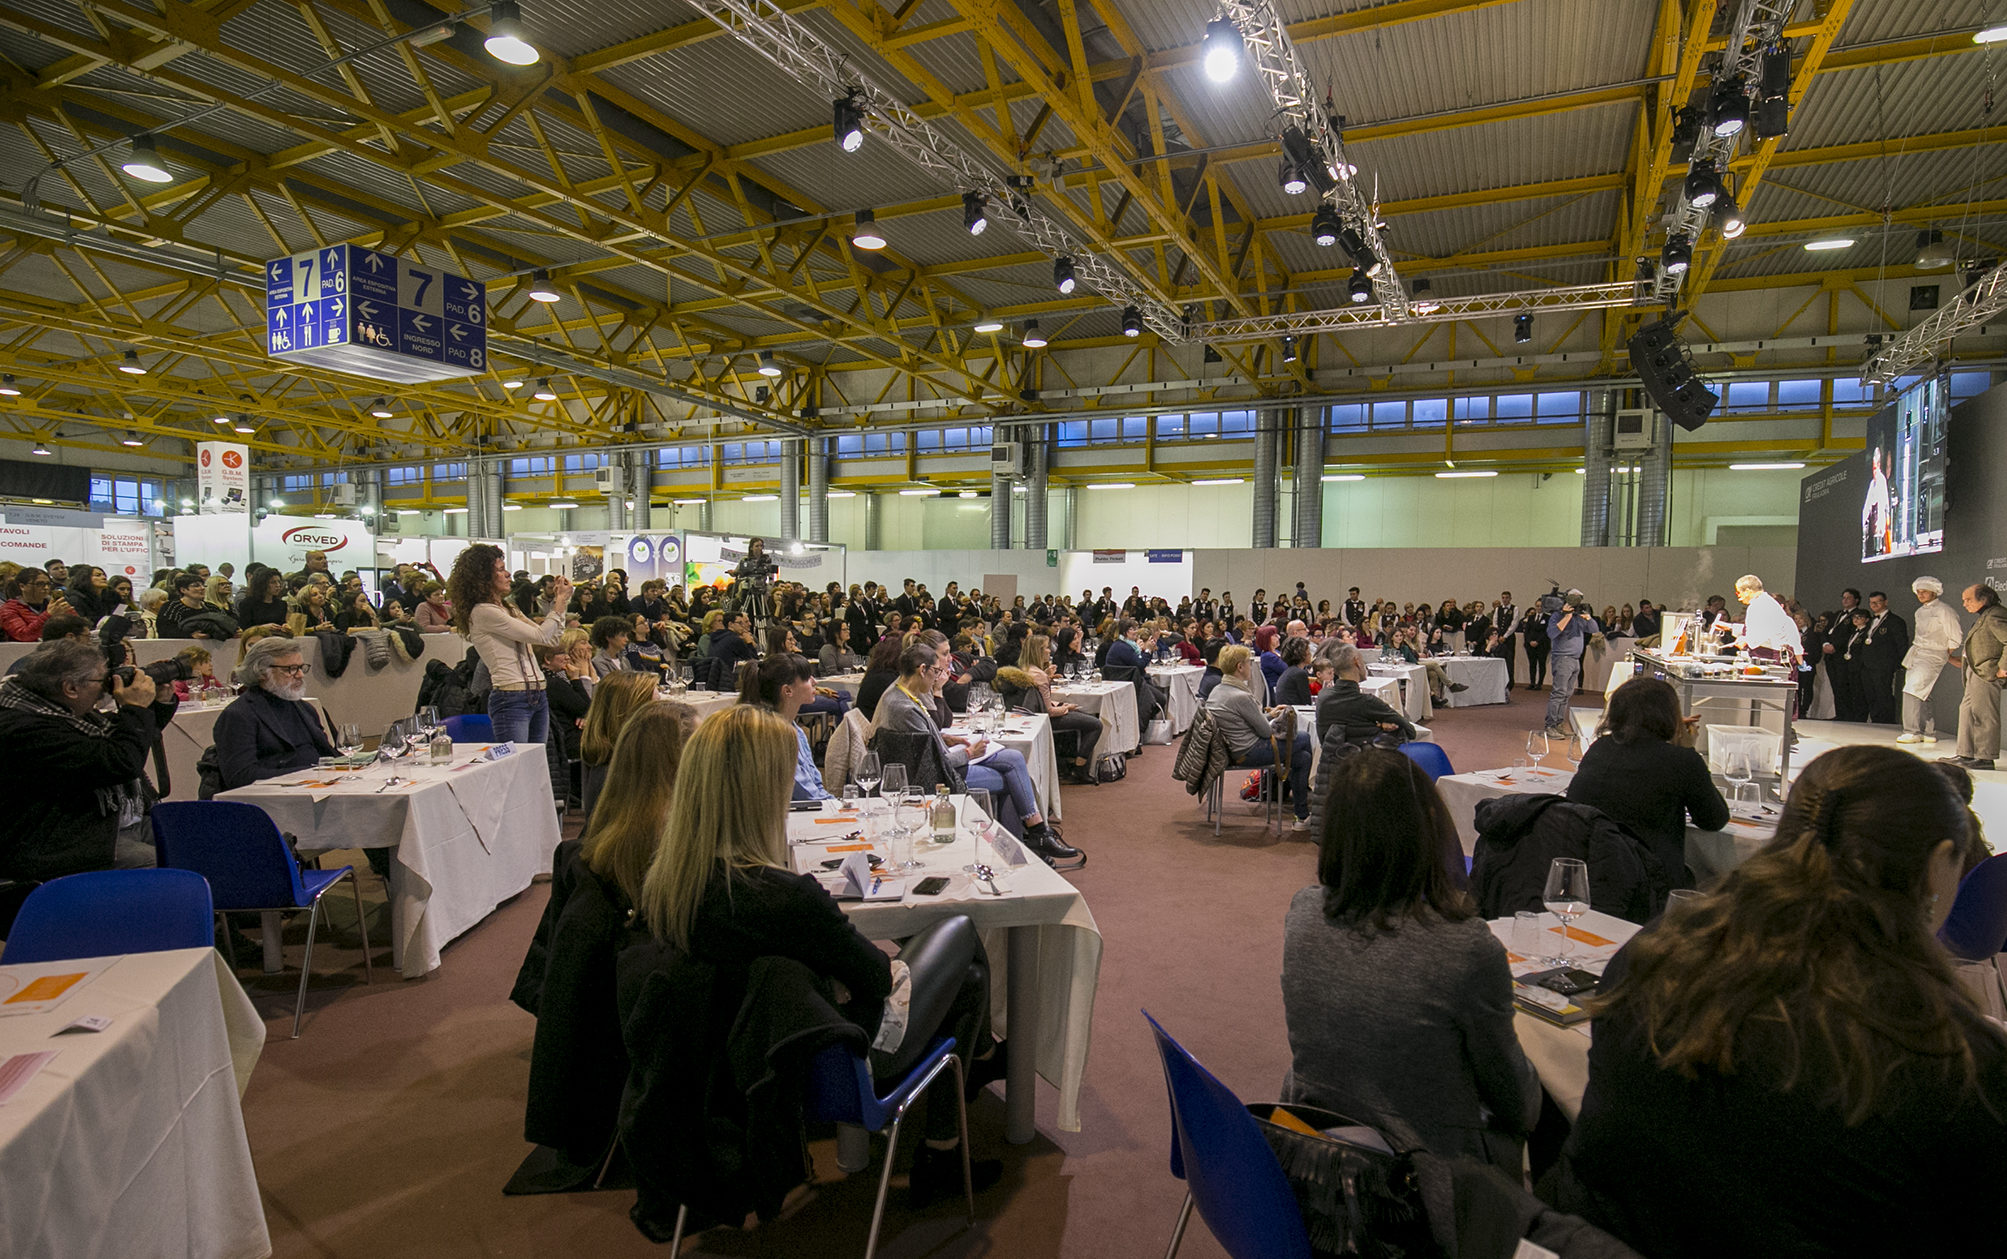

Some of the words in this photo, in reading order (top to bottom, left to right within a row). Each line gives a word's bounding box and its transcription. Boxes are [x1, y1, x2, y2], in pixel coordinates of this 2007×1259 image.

[299, 259, 314, 297] 7
[322, 278, 335, 290] PAD.
[335, 271, 344, 292] 6
[352, 275, 367, 284] AREA
[367, 279, 396, 293] ESPOSITIVA
[363, 284, 387, 295] ESTERNA
[408, 269, 433, 308] 7
[446, 302, 466, 315] PAD.
[467, 304, 481, 324] 6
[403, 333, 441, 348] INGRESSO
[412, 344, 434, 354] NORD
[448, 347, 468, 359] PAD.
[469, 348, 483, 368] 8
[1, 541, 47, 549] COMANDE
[293, 534, 339, 545] ORVED
